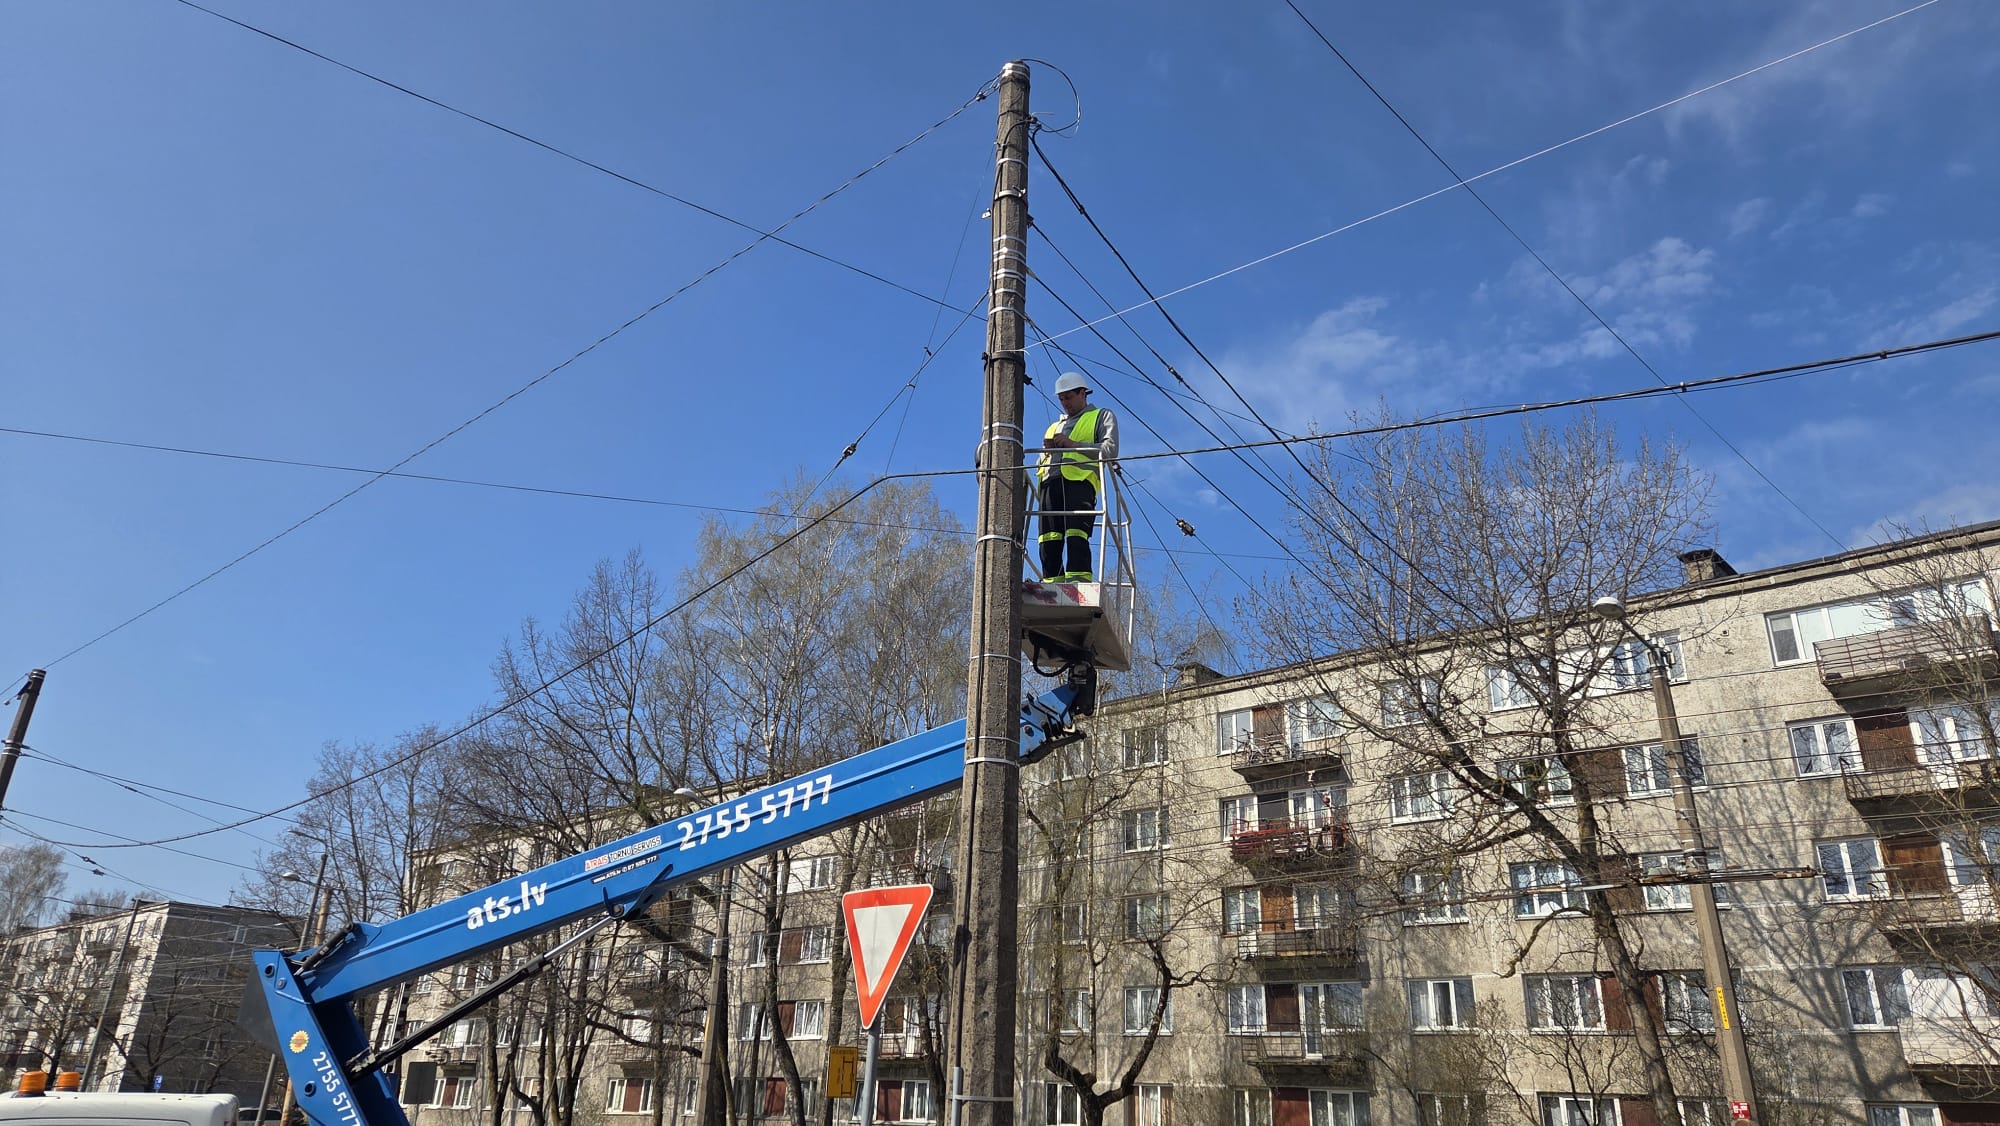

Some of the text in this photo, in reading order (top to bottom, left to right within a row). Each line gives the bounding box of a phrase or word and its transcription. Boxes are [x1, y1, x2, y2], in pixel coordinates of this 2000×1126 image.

[677, 774, 833, 851] 2755 5777
[632, 835, 661, 855] SERVISS
[467, 880, 547, 930] ats.lv
[312, 1051, 340, 1093] 2755
